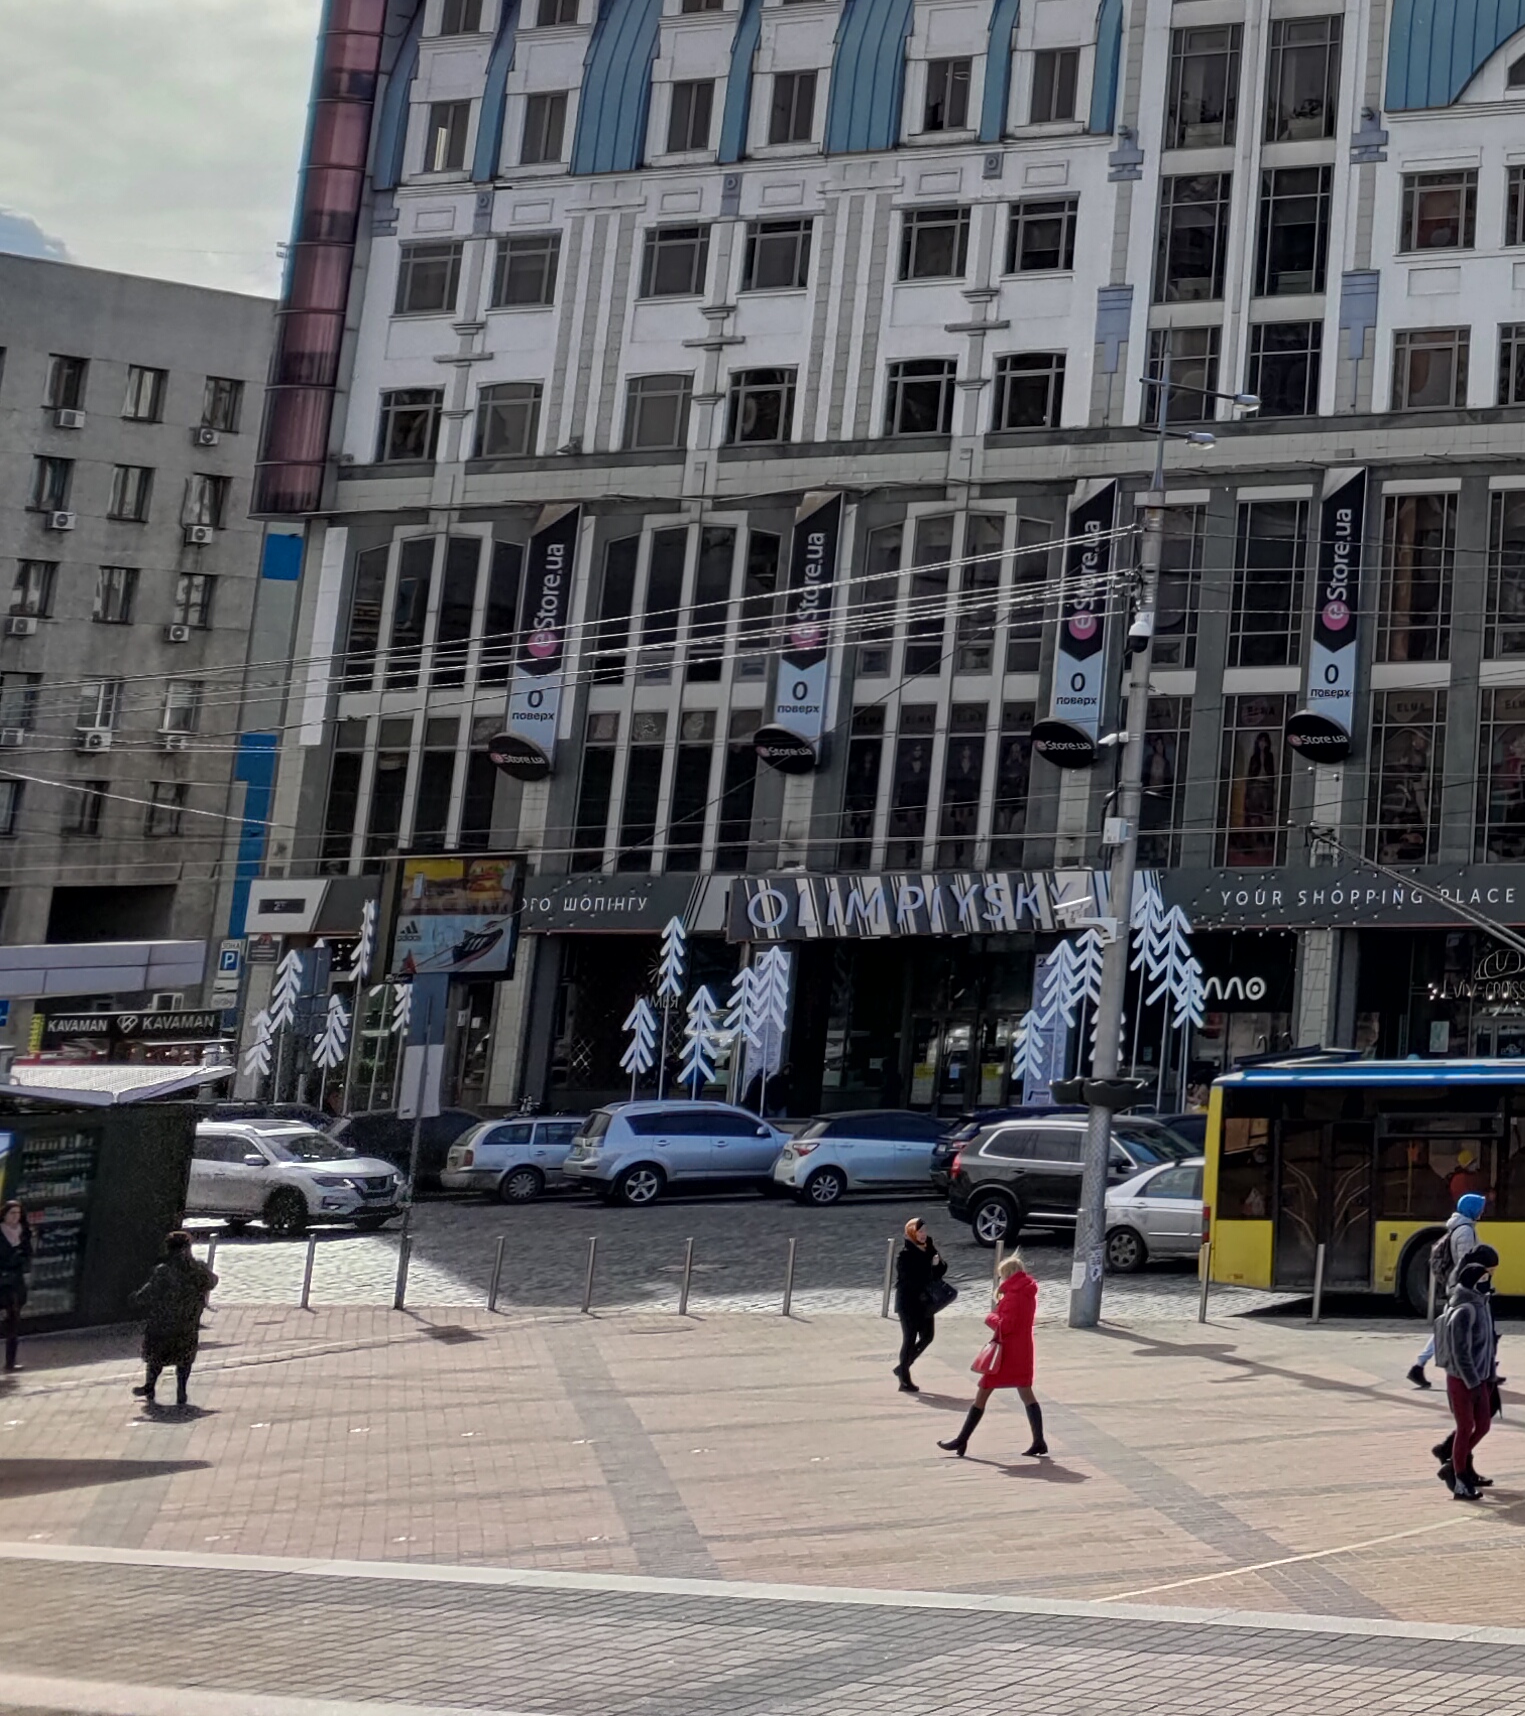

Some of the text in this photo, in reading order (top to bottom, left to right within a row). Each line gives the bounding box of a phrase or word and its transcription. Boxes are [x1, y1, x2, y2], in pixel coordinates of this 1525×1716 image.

[1327, 508, 1352, 619] eStore.ua
[1056, 695, 1097, 707] поверх
[1310, 687, 1350, 699] поверх
[512, 711, 555, 722] поверх
[777, 703, 820, 714] поверх
[563, 896, 648, 912] ШОПІНГУ
[1221, 887, 1517, 906] YOUR SHOPPING PLACE
[748, 883, 1071, 929] OLIMPIYSKY
[224, 952, 235, 969] P
[47, 1019, 108, 1033] KAVAMAN
[142, 1015, 215, 1030] KAVAMAN
